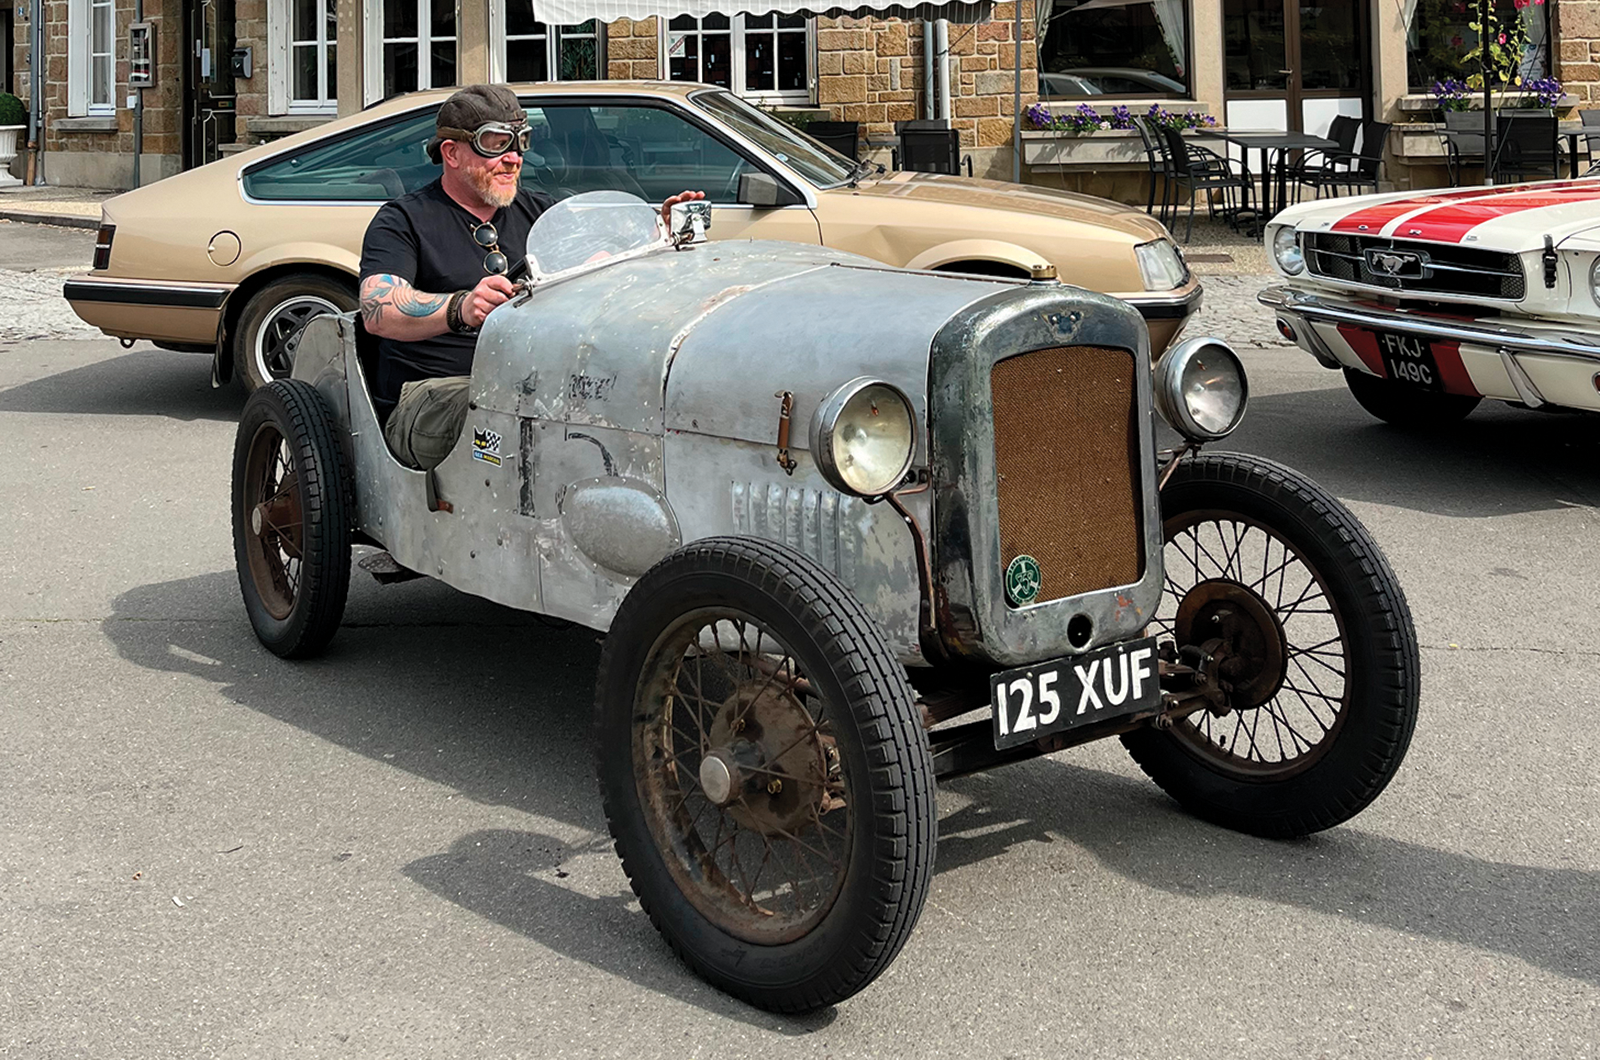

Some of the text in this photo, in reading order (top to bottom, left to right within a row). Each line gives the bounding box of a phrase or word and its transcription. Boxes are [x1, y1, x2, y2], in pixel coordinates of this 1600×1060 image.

[1384, 333, 1422, 358] FKJ
[1390, 358, 1432, 384] 149C
[996, 647, 1152, 736] 125 XUF
